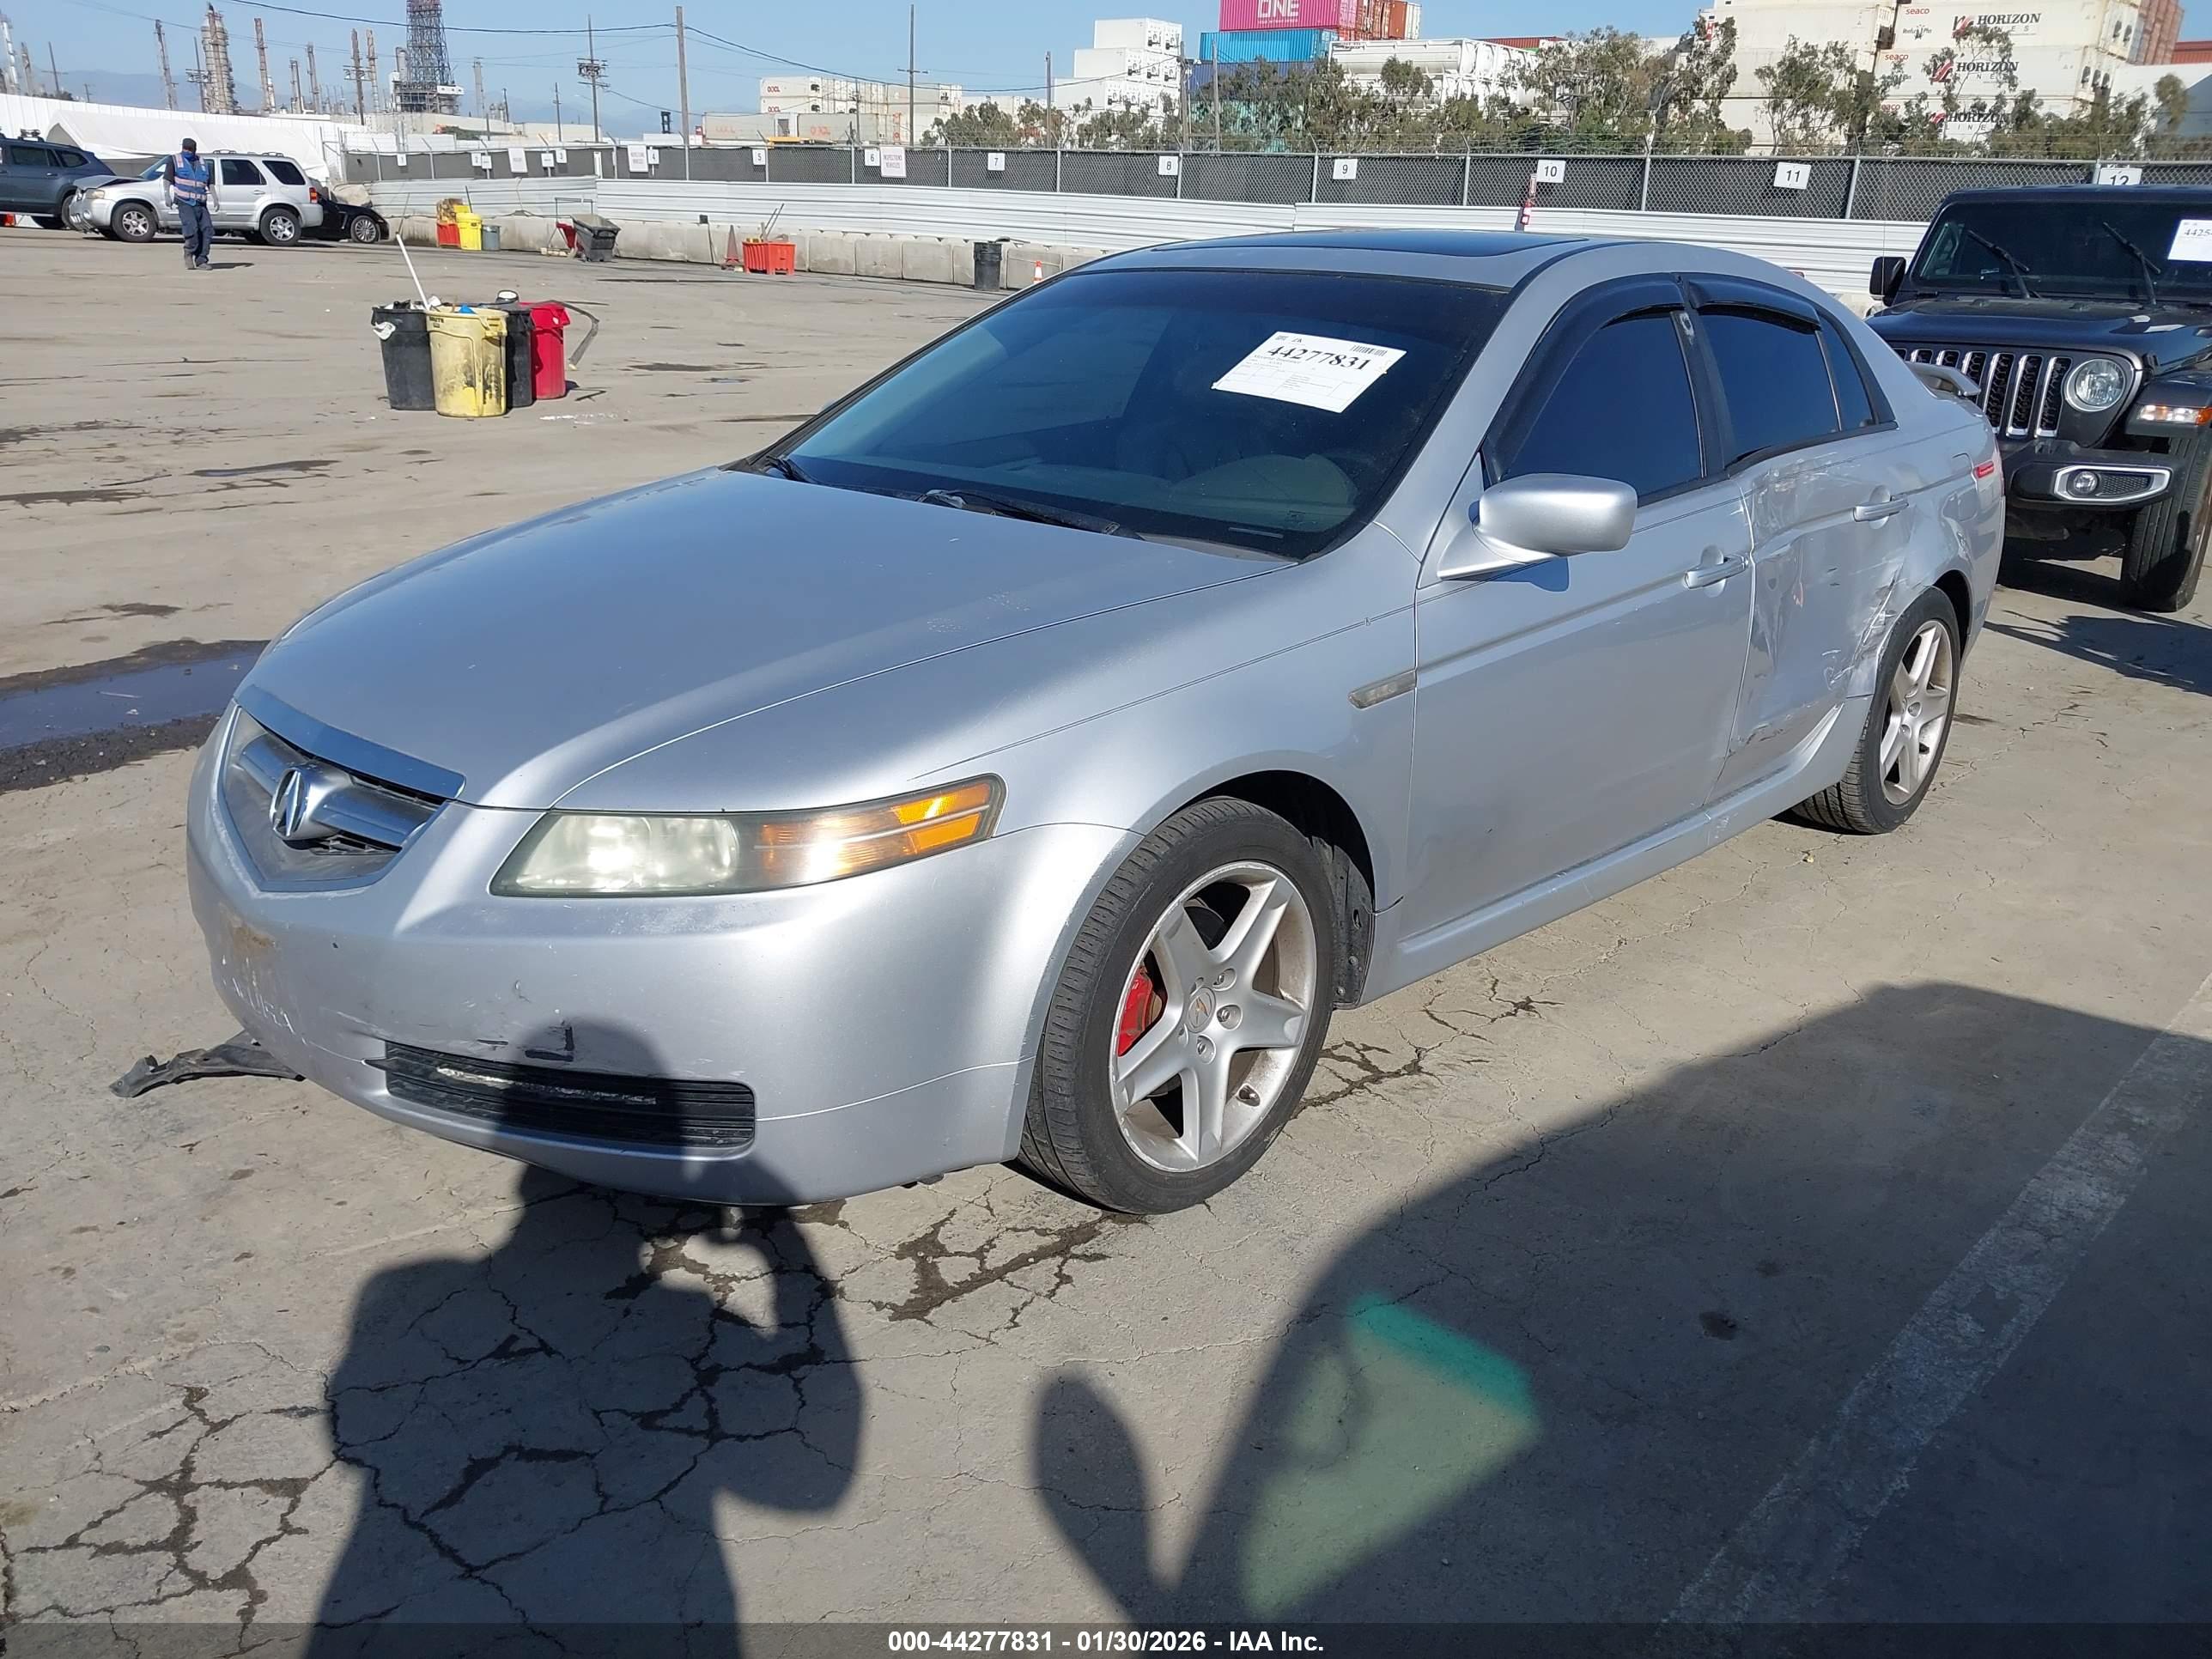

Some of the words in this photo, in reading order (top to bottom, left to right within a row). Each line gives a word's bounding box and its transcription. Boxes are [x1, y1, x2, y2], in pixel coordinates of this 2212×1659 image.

[1257, 0, 1298, 17] ONE
[1977, 13, 2041, 25] HORIZON
[1956, 62, 2020, 72] HORIZON
[1166, 161, 1172, 171] 8
[1342, 164, 1348, 174] 9
[1544, 166, 1558, 178] 10
[1786, 169, 1801, 183] 11
[2110, 174, 2130, 185] 12
[1267, 345, 1372, 370] 44277831
